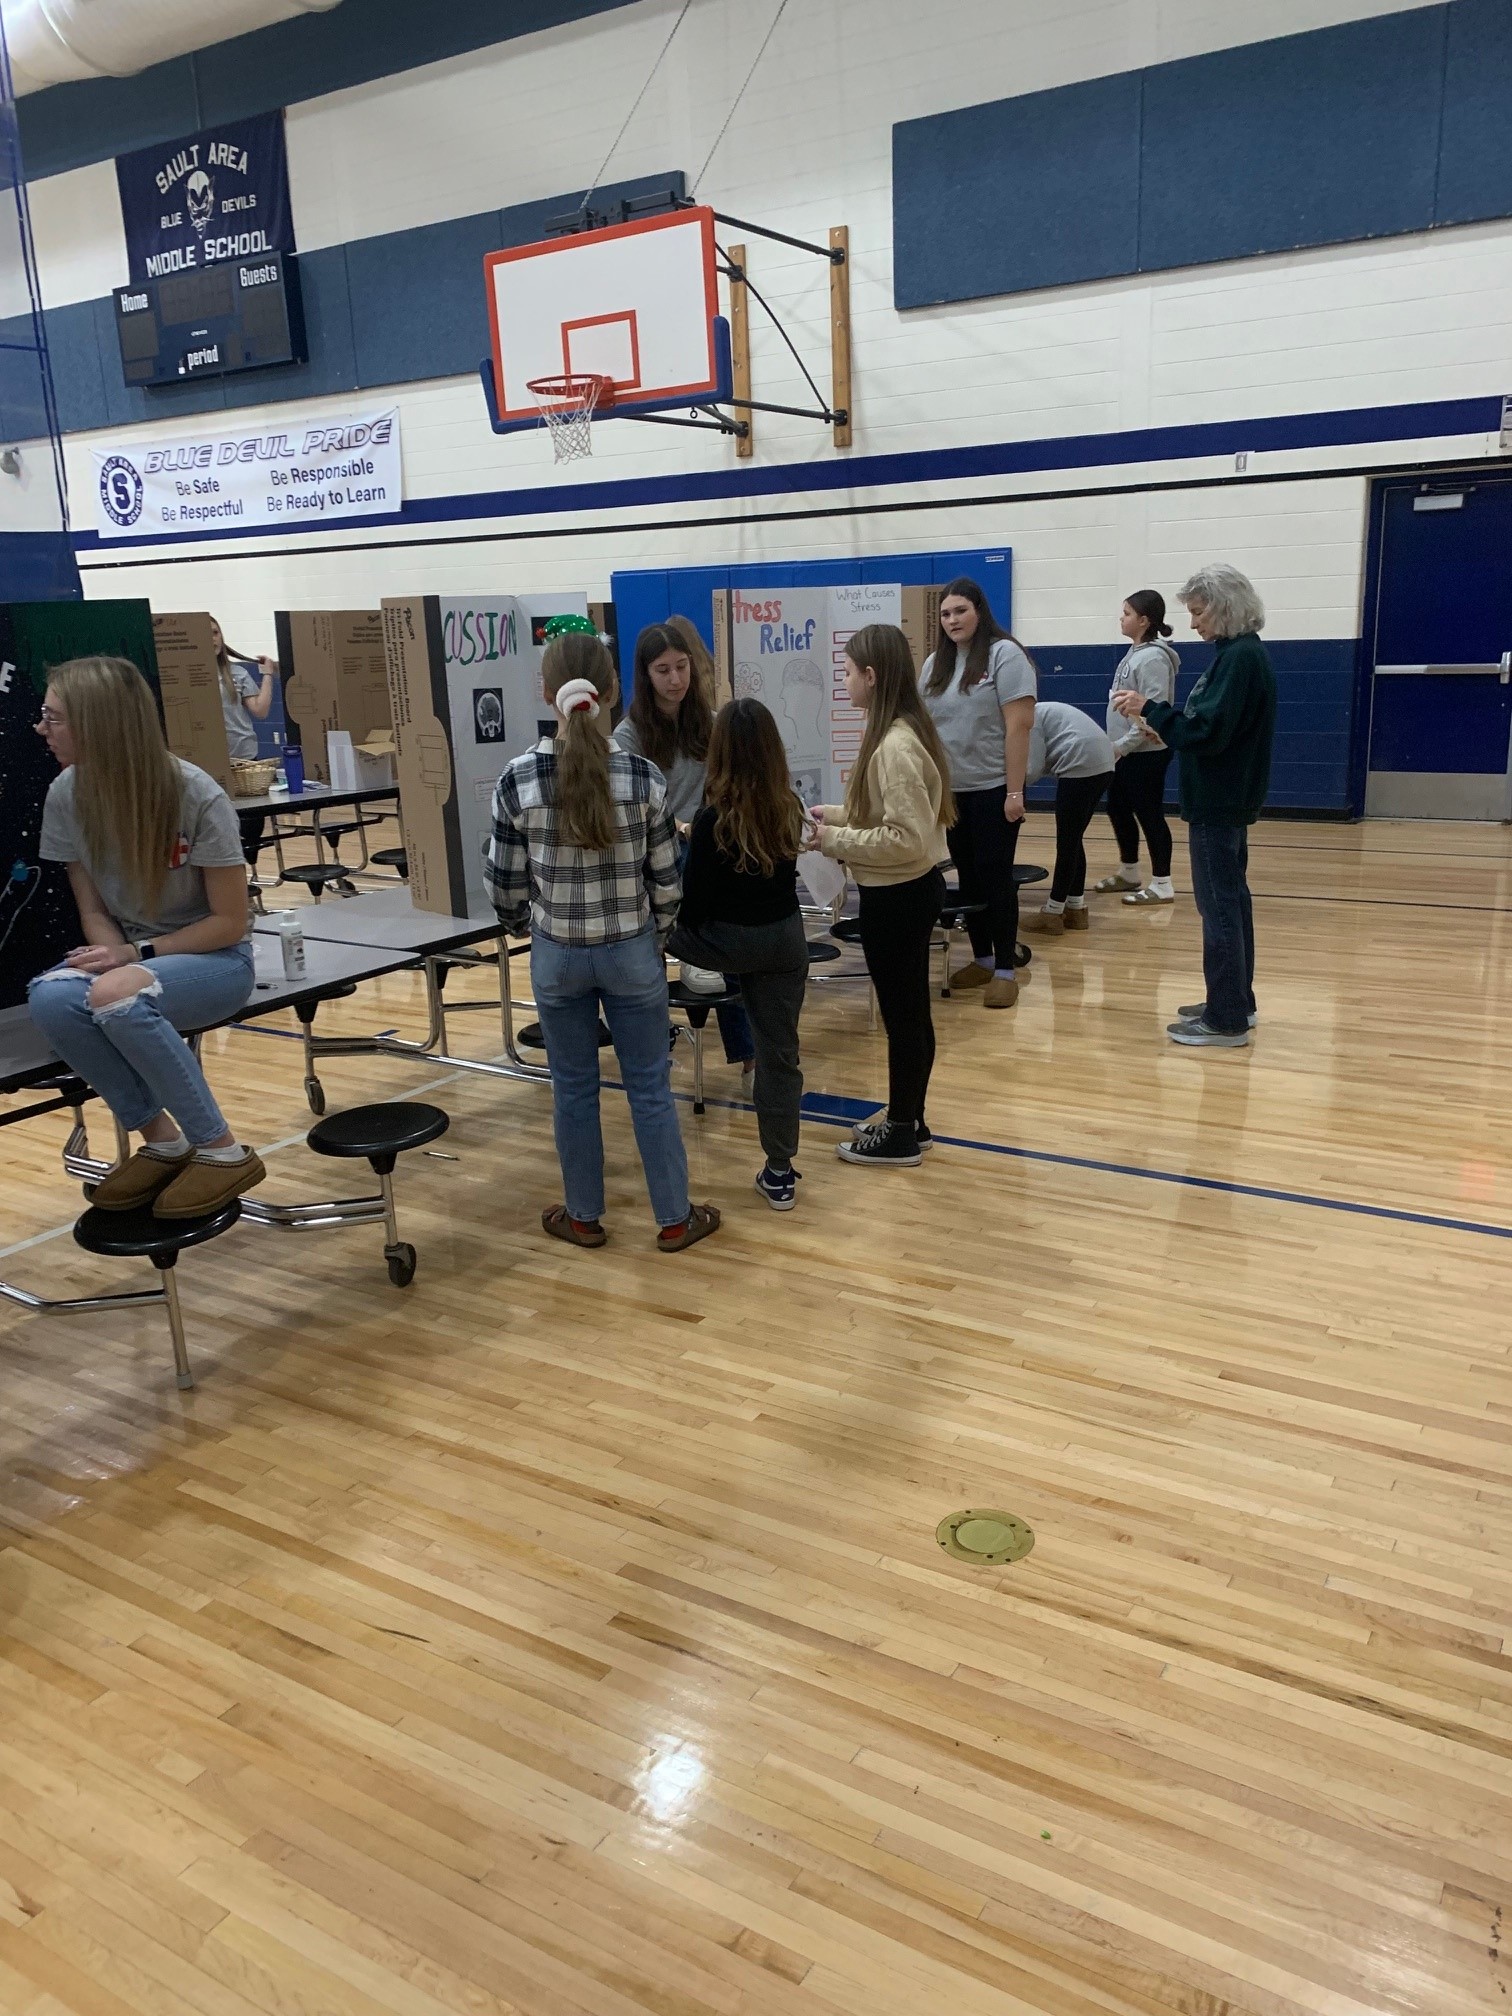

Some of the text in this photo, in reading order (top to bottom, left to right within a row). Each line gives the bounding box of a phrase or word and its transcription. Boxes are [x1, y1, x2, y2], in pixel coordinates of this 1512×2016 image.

[156, 142, 248, 194] SAULT AREA
[221, 194, 256, 213] DEVILS
[160, 211, 183, 229] BLUE
[145, 229, 273, 278] MIDDLE SCHOOL
[239, 264, 278, 287] Guests
[120, 293, 148, 312] Home
[187, 344, 219, 371] period
[144, 418, 392, 473] BLUE DEVIL PRIDE
[270, 458, 374, 486] Be Responsible
[112, 472, 131, 510] S
[175, 477, 220, 496] Be Safe
[267, 485, 386, 512] Be Ready to Learn
[161, 499, 243, 523] Be Respectful
[732, 590, 782, 624] tress
[836, 587, 895, 601] What Causes
[851, 601, 881, 613] Stress
[444, 609, 517, 666] CUSSION
[760, 618, 816, 654] Relief
